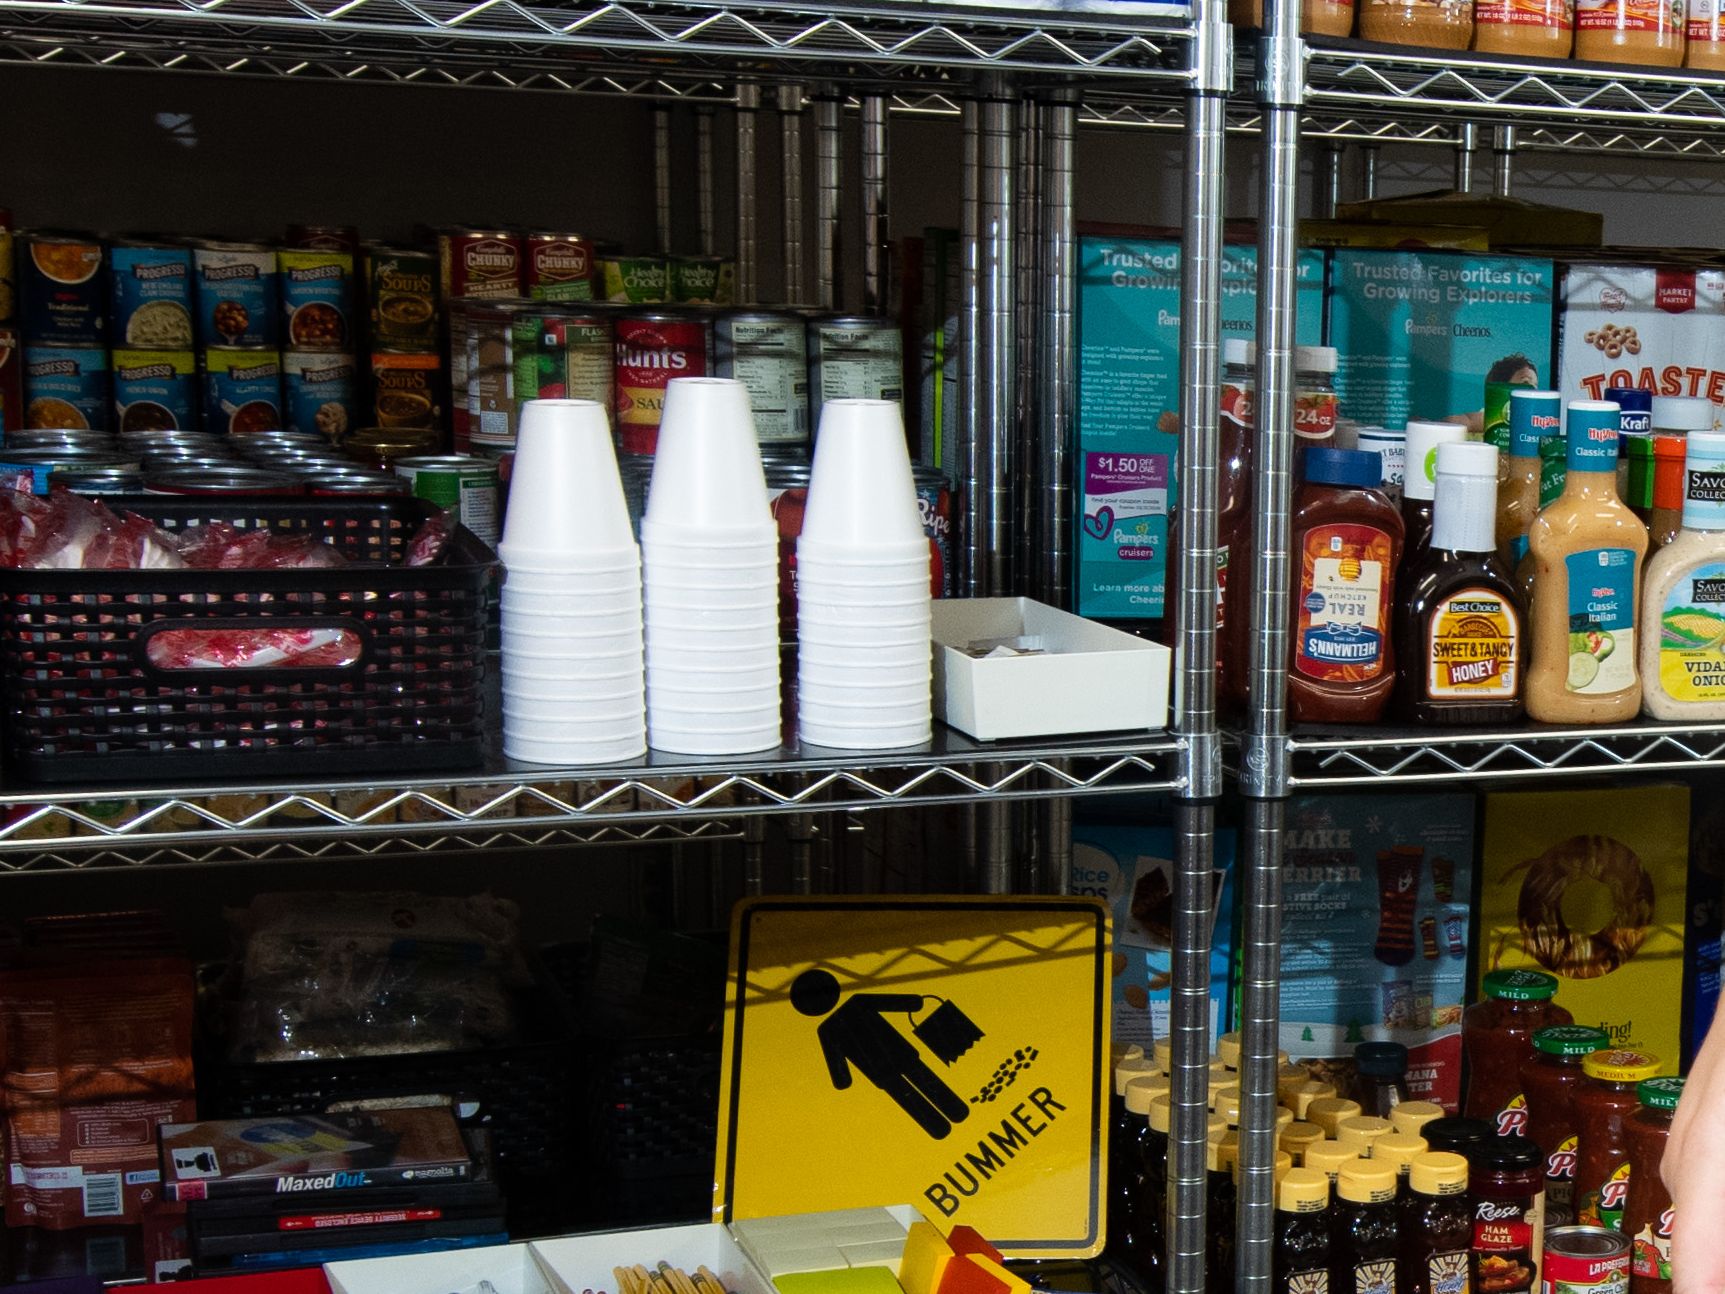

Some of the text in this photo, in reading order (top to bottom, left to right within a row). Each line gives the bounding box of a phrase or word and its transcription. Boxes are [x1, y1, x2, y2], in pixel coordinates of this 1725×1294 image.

[465, 251, 518, 274] CHUNKY
[533, 253, 586, 275] CHUNKY
[135, 263, 187, 282] PROGRESSO
[204, 264, 258, 282] PROGRESSO
[291, 264, 342, 283] PROGRESSO
[1352, 262, 1543, 285] Trusted Favorites for
[1362, 282, 1533, 306] Growing Explorers
[1658, 287, 1693, 298] MARKET
[1405, 318, 1447, 337] Pampers
[121, 364, 172, 382] PROGRESSO
[1295, 408, 1318, 425] 24
[1619, 416, 1650, 431] Kraft
[1575, 446, 1605, 457] Classic
[1113, 530, 1160, 547] Pampers
[1118, 547, 1155, 559] cruisers
[1328, 593, 1367, 602] KETCHUP
[1329, 602, 1366, 617] REAL
[1450, 602, 1501, 614] Best Choice
[1587, 601, 1618, 613] Classic
[1588, 611, 1617, 623] Italian
[1308, 638, 1378, 657] HELLMANN'S
[1451, 661, 1495, 683] HONEY
[1498, 989, 1530, 1001] MILD
[1562, 1044, 1596, 1056] MILD
[922, 1085, 1068, 1219] BUMMER
[1480, 1232, 1514, 1244] GLAZE
[1484, 1225, 1510, 1236] HAM
